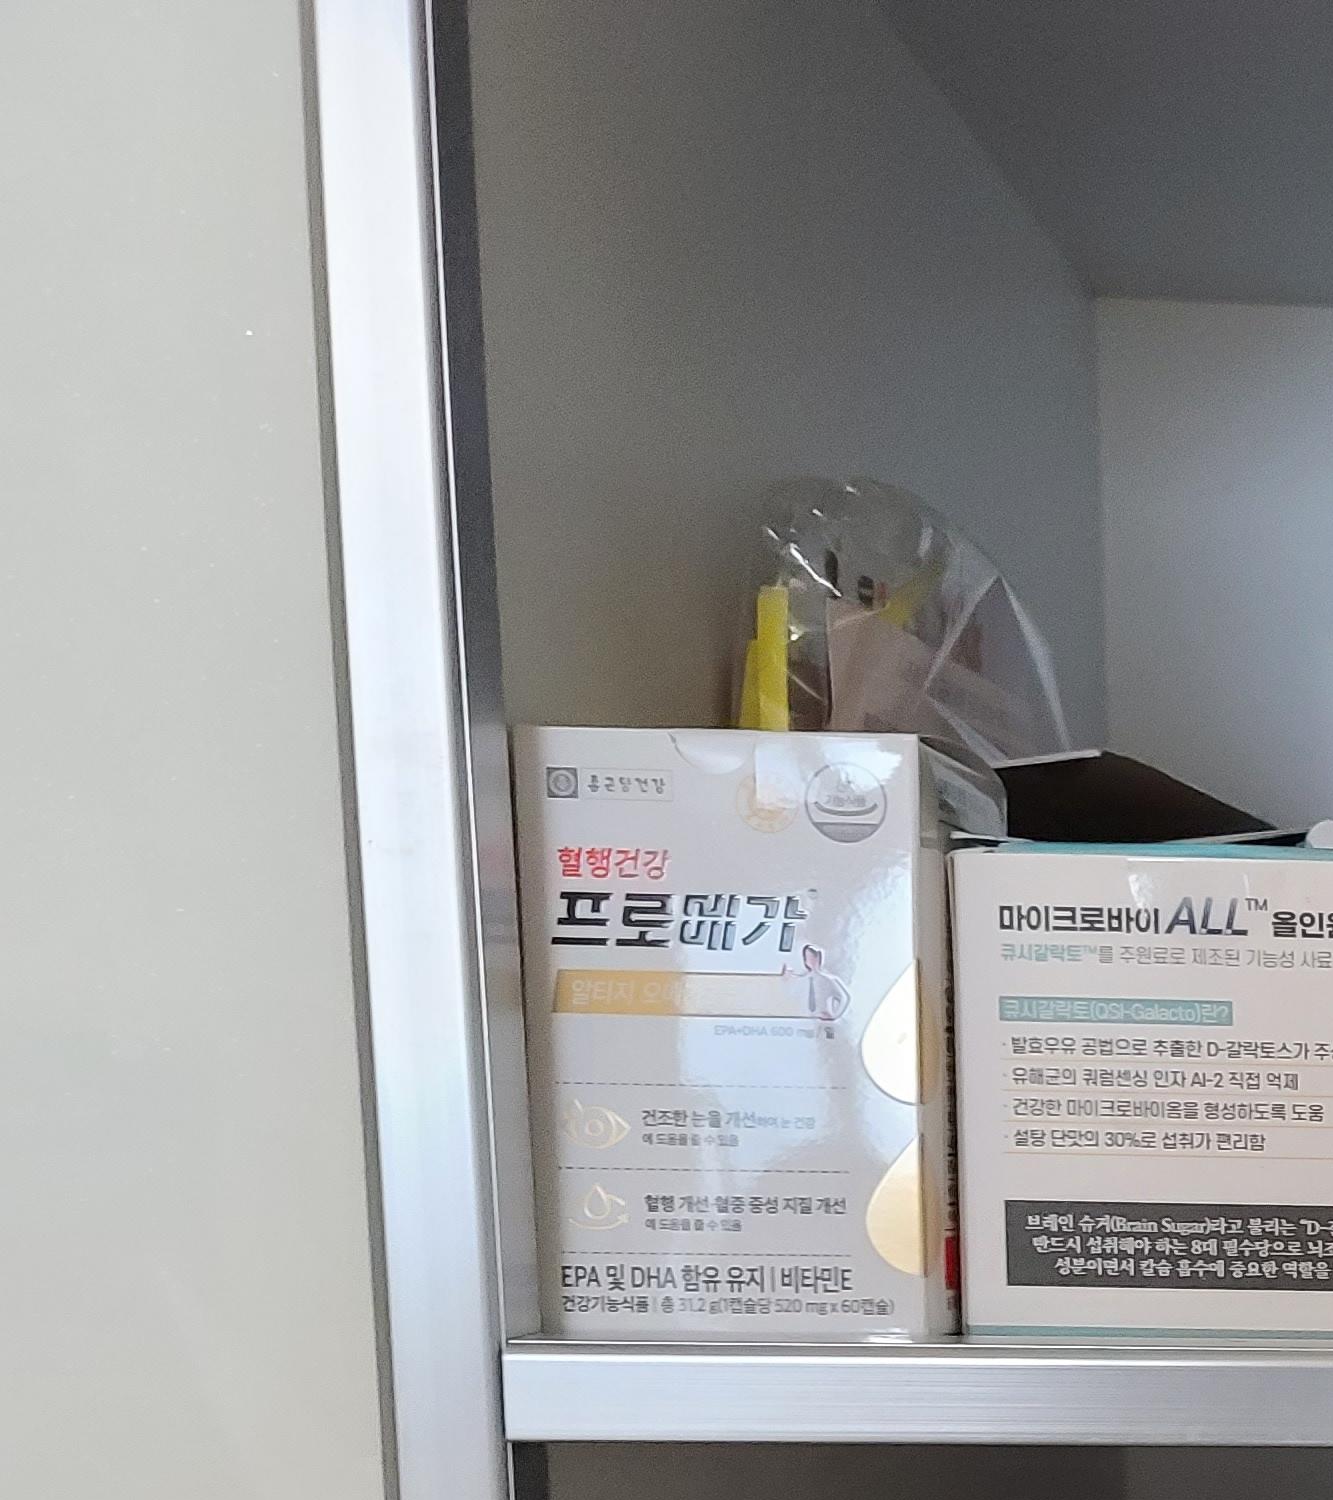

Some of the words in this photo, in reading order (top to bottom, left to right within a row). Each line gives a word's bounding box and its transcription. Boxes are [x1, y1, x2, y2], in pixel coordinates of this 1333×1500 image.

[557, 846, 671, 880] 혈행건강
[999, 904, 1160, 934] 마이크로바이
[1119, 946, 1187, 967] 주원료로
[1191, 947, 1241, 968] 제조된
[1247, 949, 1295, 969] 기능성
[1299, 950, 1333, 969] 사료
[1011, 1036, 1077, 1056] 발효우유
[1081, 1037, 1148, 1057] 공법으로
[1152, 1039, 1202, 1059] 추출한
[1206, 1041, 1310, 1061] D-갈락토스가
[1012, 1066, 1077, 1087] 유해균의
[1152, 1070, 1186, 1089] 인자
[1229, 1071, 1261, 1091] 직접
[1266, 1072, 1299, 1091] 억제
[641, 1108, 689, 1128] 건조한
[1012, 1098, 1062, 1118] 건강한
[1066, 1099, 1200, 1121] 마이크로바이옴을
[1204, 1101, 1288, 1122] 형성하도록
[1290, 1103, 1324, 1123] 도움
[1013, 1128, 1046, 1149] 설탕
[1050, 1129, 1100, 1149] 단맛의
[1103, 1130, 1157, 1149] 30%로
[1162, 1132, 1212, 1152] 섭취가
[1216, 1133, 1266, 1153] 편리함
[815, 1197, 848, 1215] 개선
[1025, 1213, 1075, 1233] 브레인
[1246, 1217, 1298, 1238] 불리는
[1031, 1235, 1082, 1254] 반드시
[1086, 1236, 1152, 1256] 섭취해야
[1154, 1236, 1190, 1256] 하는
[1222, 1238, 1305, 1259] 필수당으로
[560, 1265, 602, 1288] EPA
[606, 1263, 627, 1292] 및
[631, 1265, 678, 1289] DHA
[681, 1264, 722, 1293] 함유
[726, 1265, 765, 1294] 유지
[780, 1264, 854, 1295] 비타민E
[1054, 1256, 1136, 1277] 성분이면서
[1138, 1258, 1174, 1278] 칼슘
[1175, 1258, 1225, 1279] 흡수에
[1229, 1259, 1280, 1280] 중요한
[1281, 1260, 1333, 1281] 역할을
[561, 1295, 650, 1314] 건강기능식품
